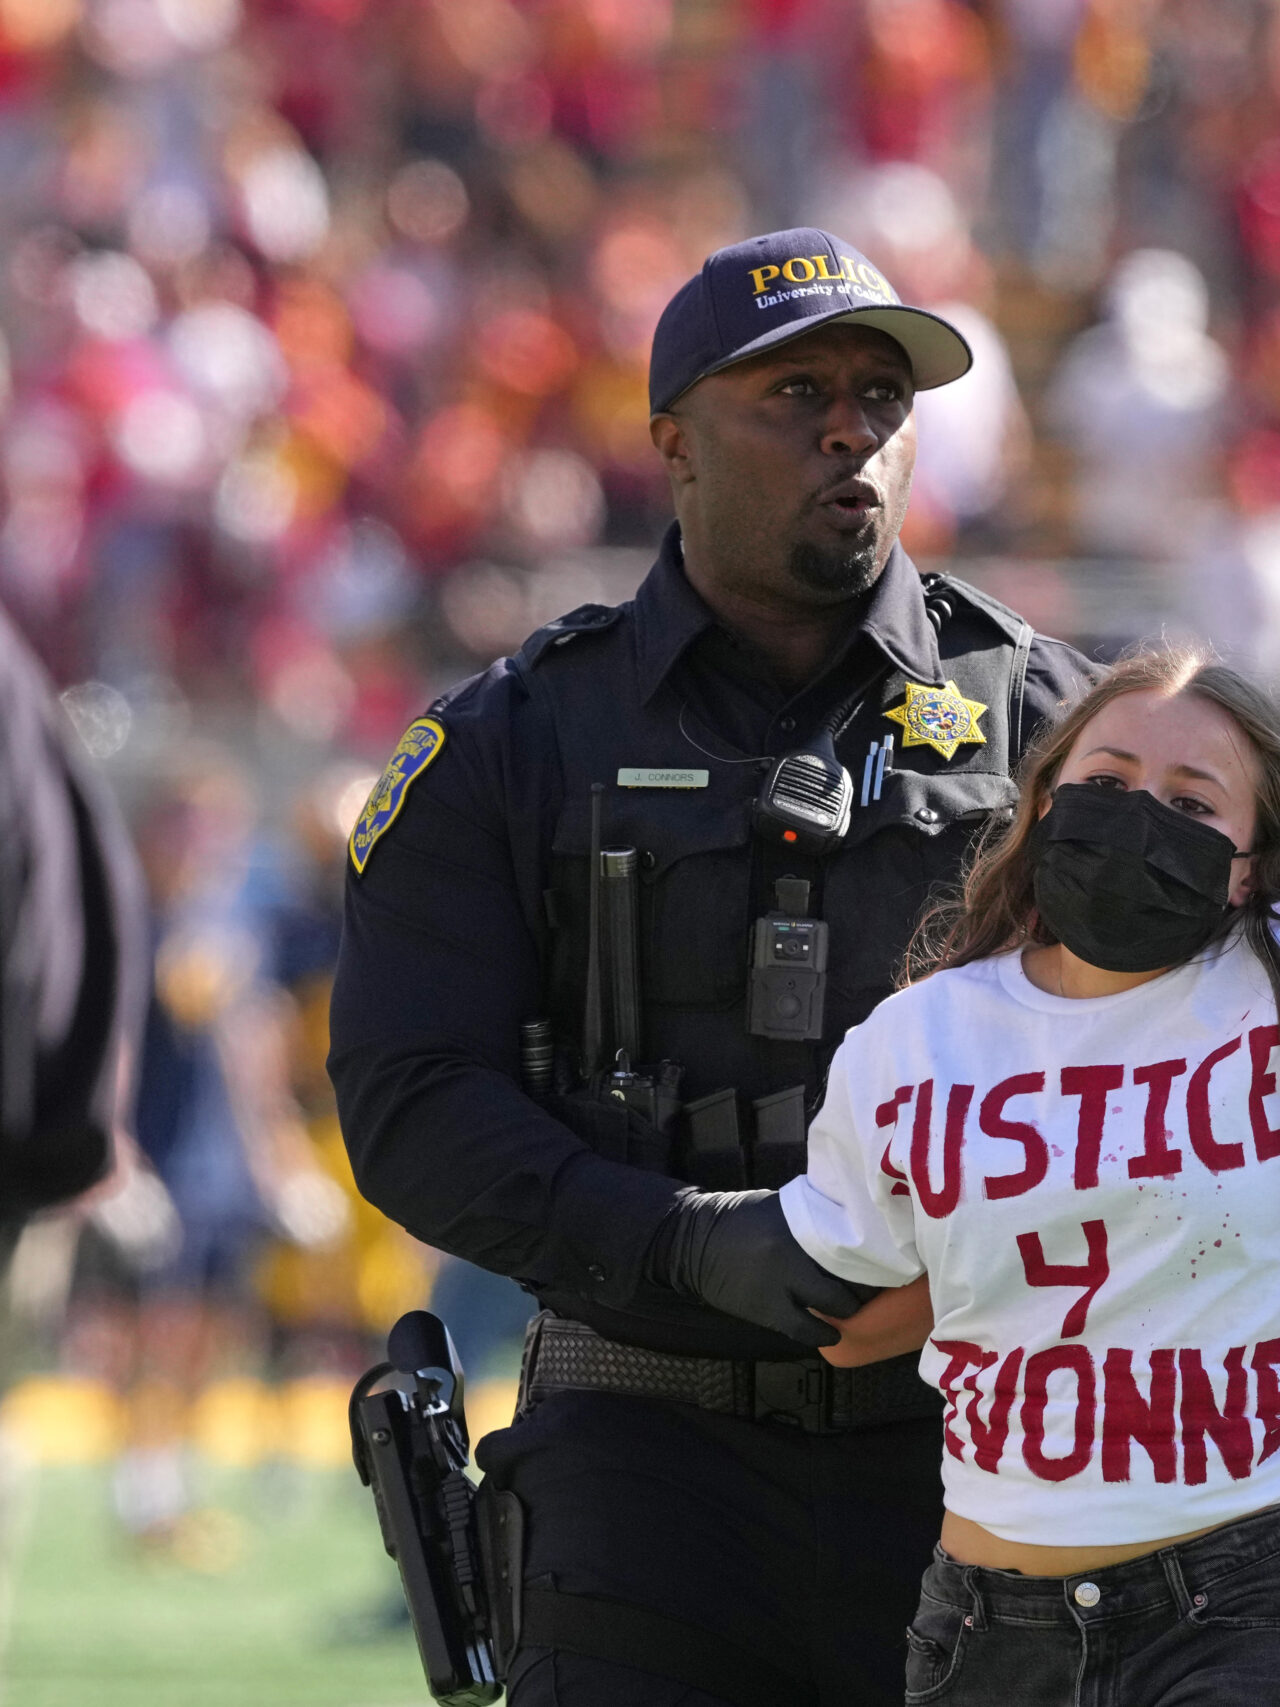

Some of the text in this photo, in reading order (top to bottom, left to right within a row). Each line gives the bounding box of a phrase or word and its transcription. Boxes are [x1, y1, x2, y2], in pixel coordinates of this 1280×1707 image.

[755, 283, 834, 310] University
[837, 284, 851, 295] of
[648, 773, 694, 782] CONNORS
[1015, 1218, 1110, 1340] 4
